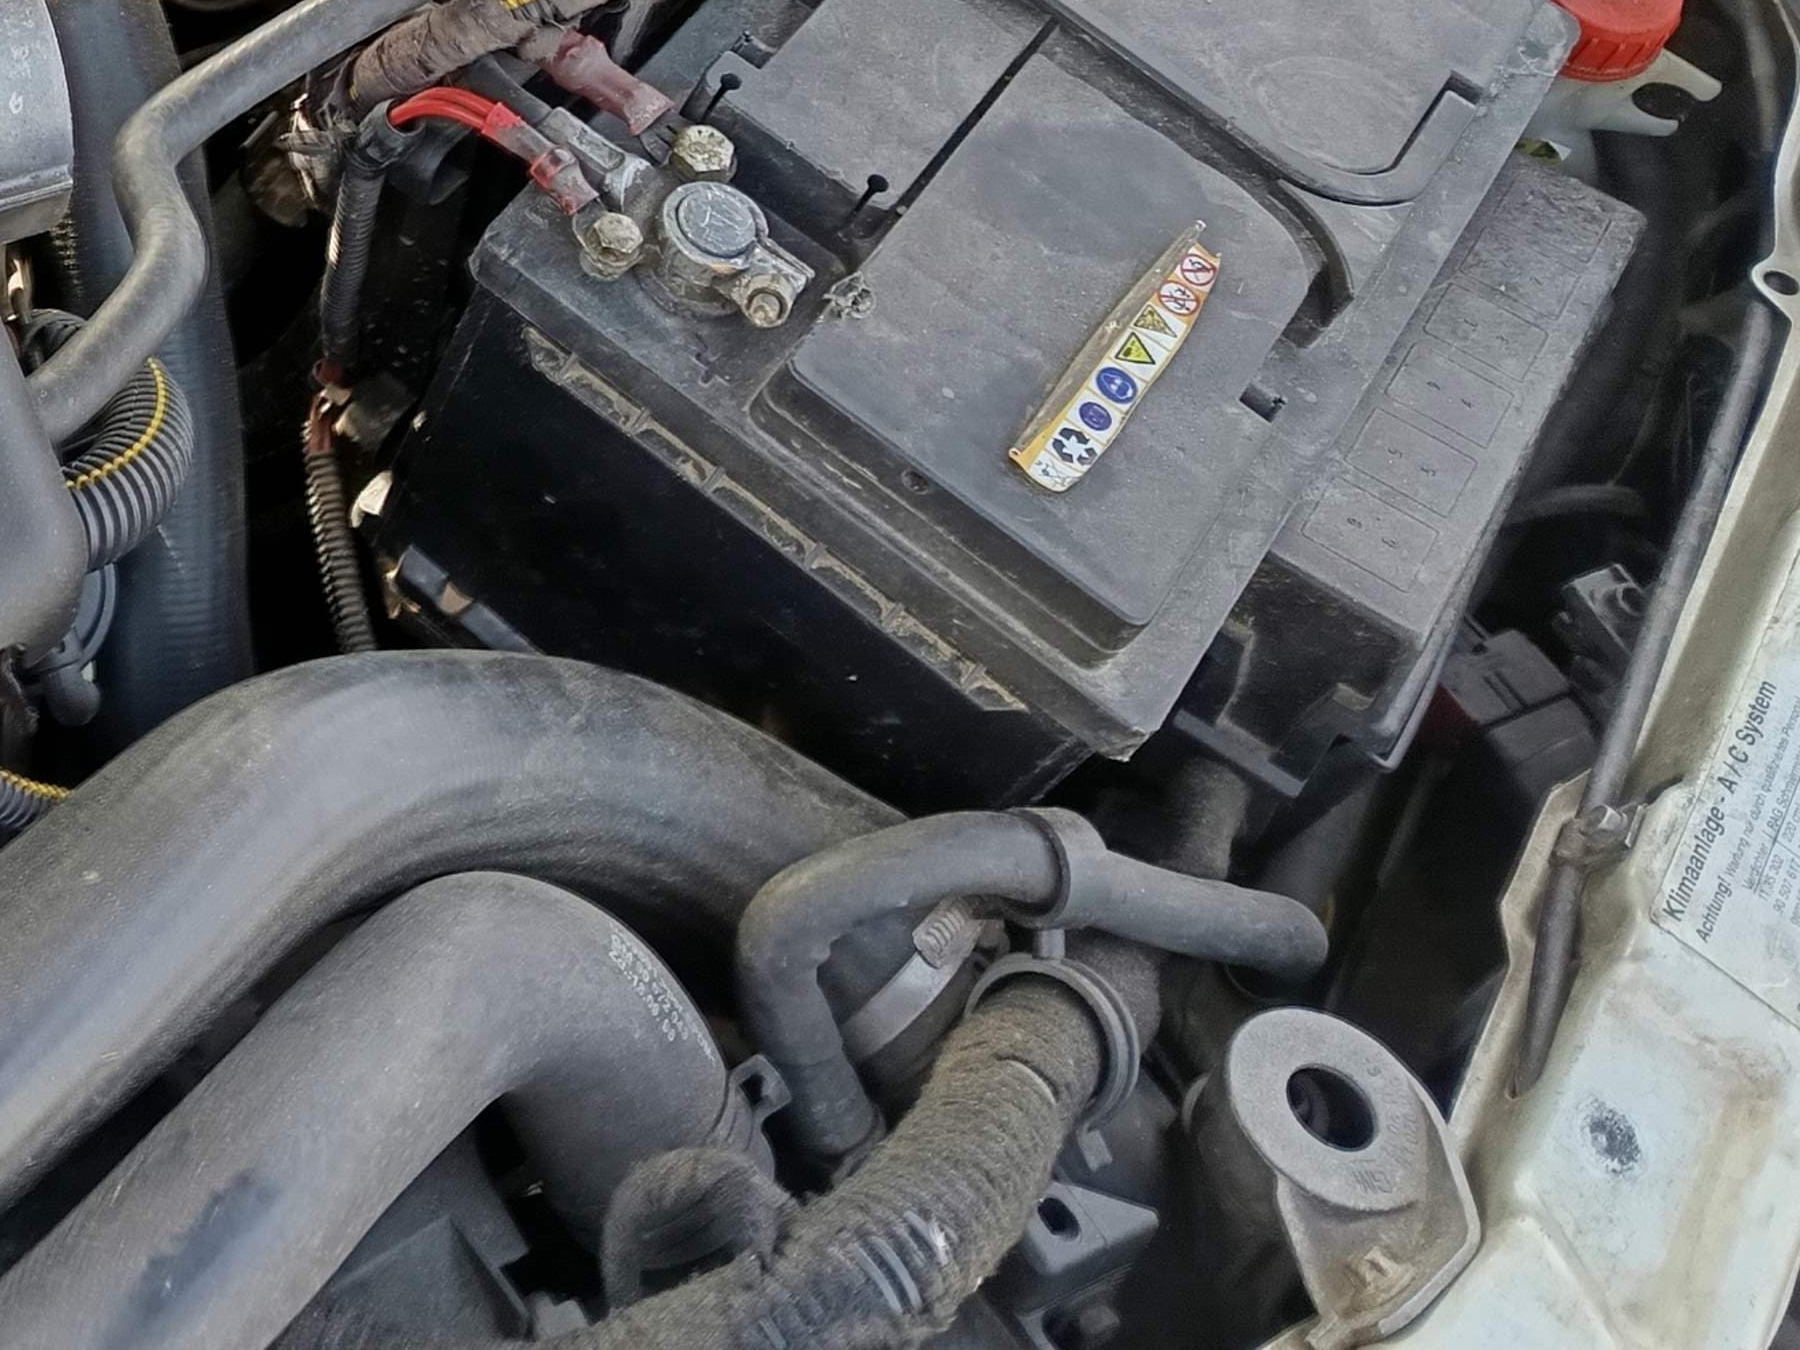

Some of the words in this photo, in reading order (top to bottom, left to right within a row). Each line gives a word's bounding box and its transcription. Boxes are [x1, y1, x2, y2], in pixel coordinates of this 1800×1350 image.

[1662, 805, 1726, 922] Klimaanlage
[1735, 680, 1777, 746] System
[1695, 874, 1733, 944] Achtung!
